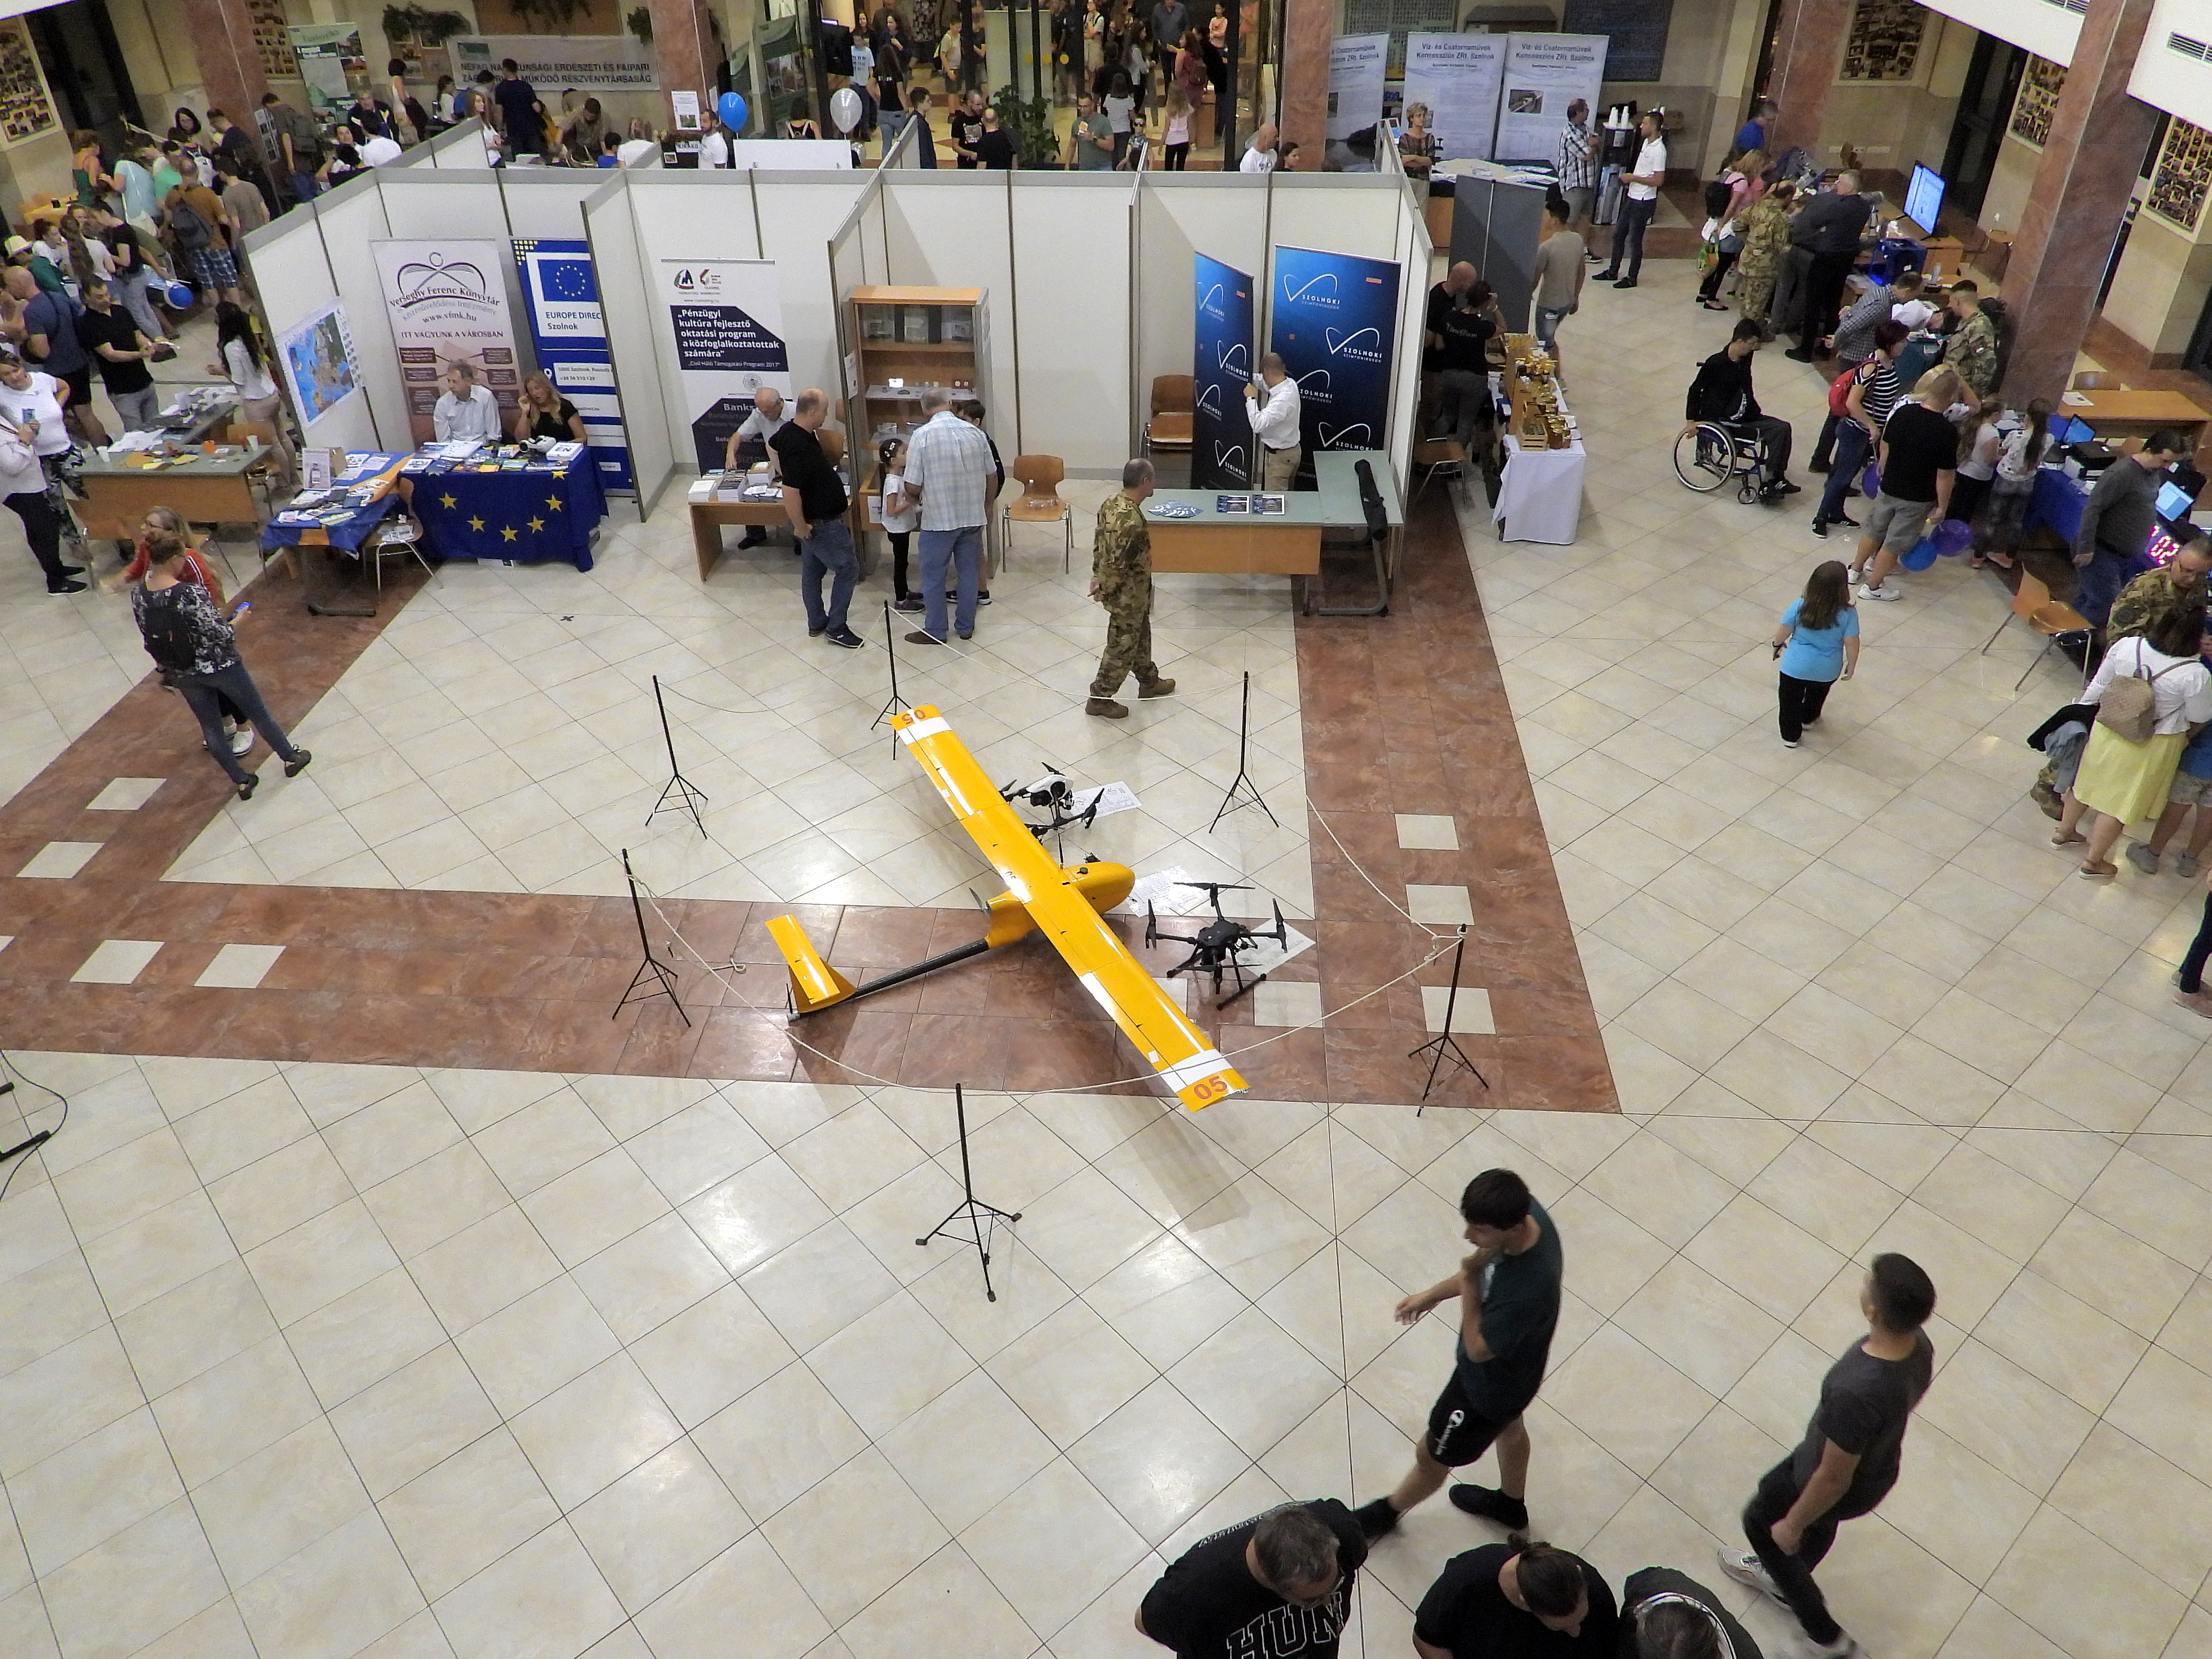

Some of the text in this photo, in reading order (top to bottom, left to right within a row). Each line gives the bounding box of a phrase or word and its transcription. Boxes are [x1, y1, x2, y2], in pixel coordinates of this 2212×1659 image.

[389, 287, 500, 307] Verseghy Ferenc Könyvtár
[1302, 294, 1341, 305] SZOLNOKI
[679, 319, 751, 329] kultúra fejlesztő
[681, 329, 756, 340] oktatási program
[689, 339, 780, 349] közfoglalkoztatottak
[1344, 347, 1382, 359] SZOLNOKI
[1299, 388, 1333, 399] ZOLNOKI
[901, 709, 926, 725] 05
[1193, 1075, 1228, 1100] 05
